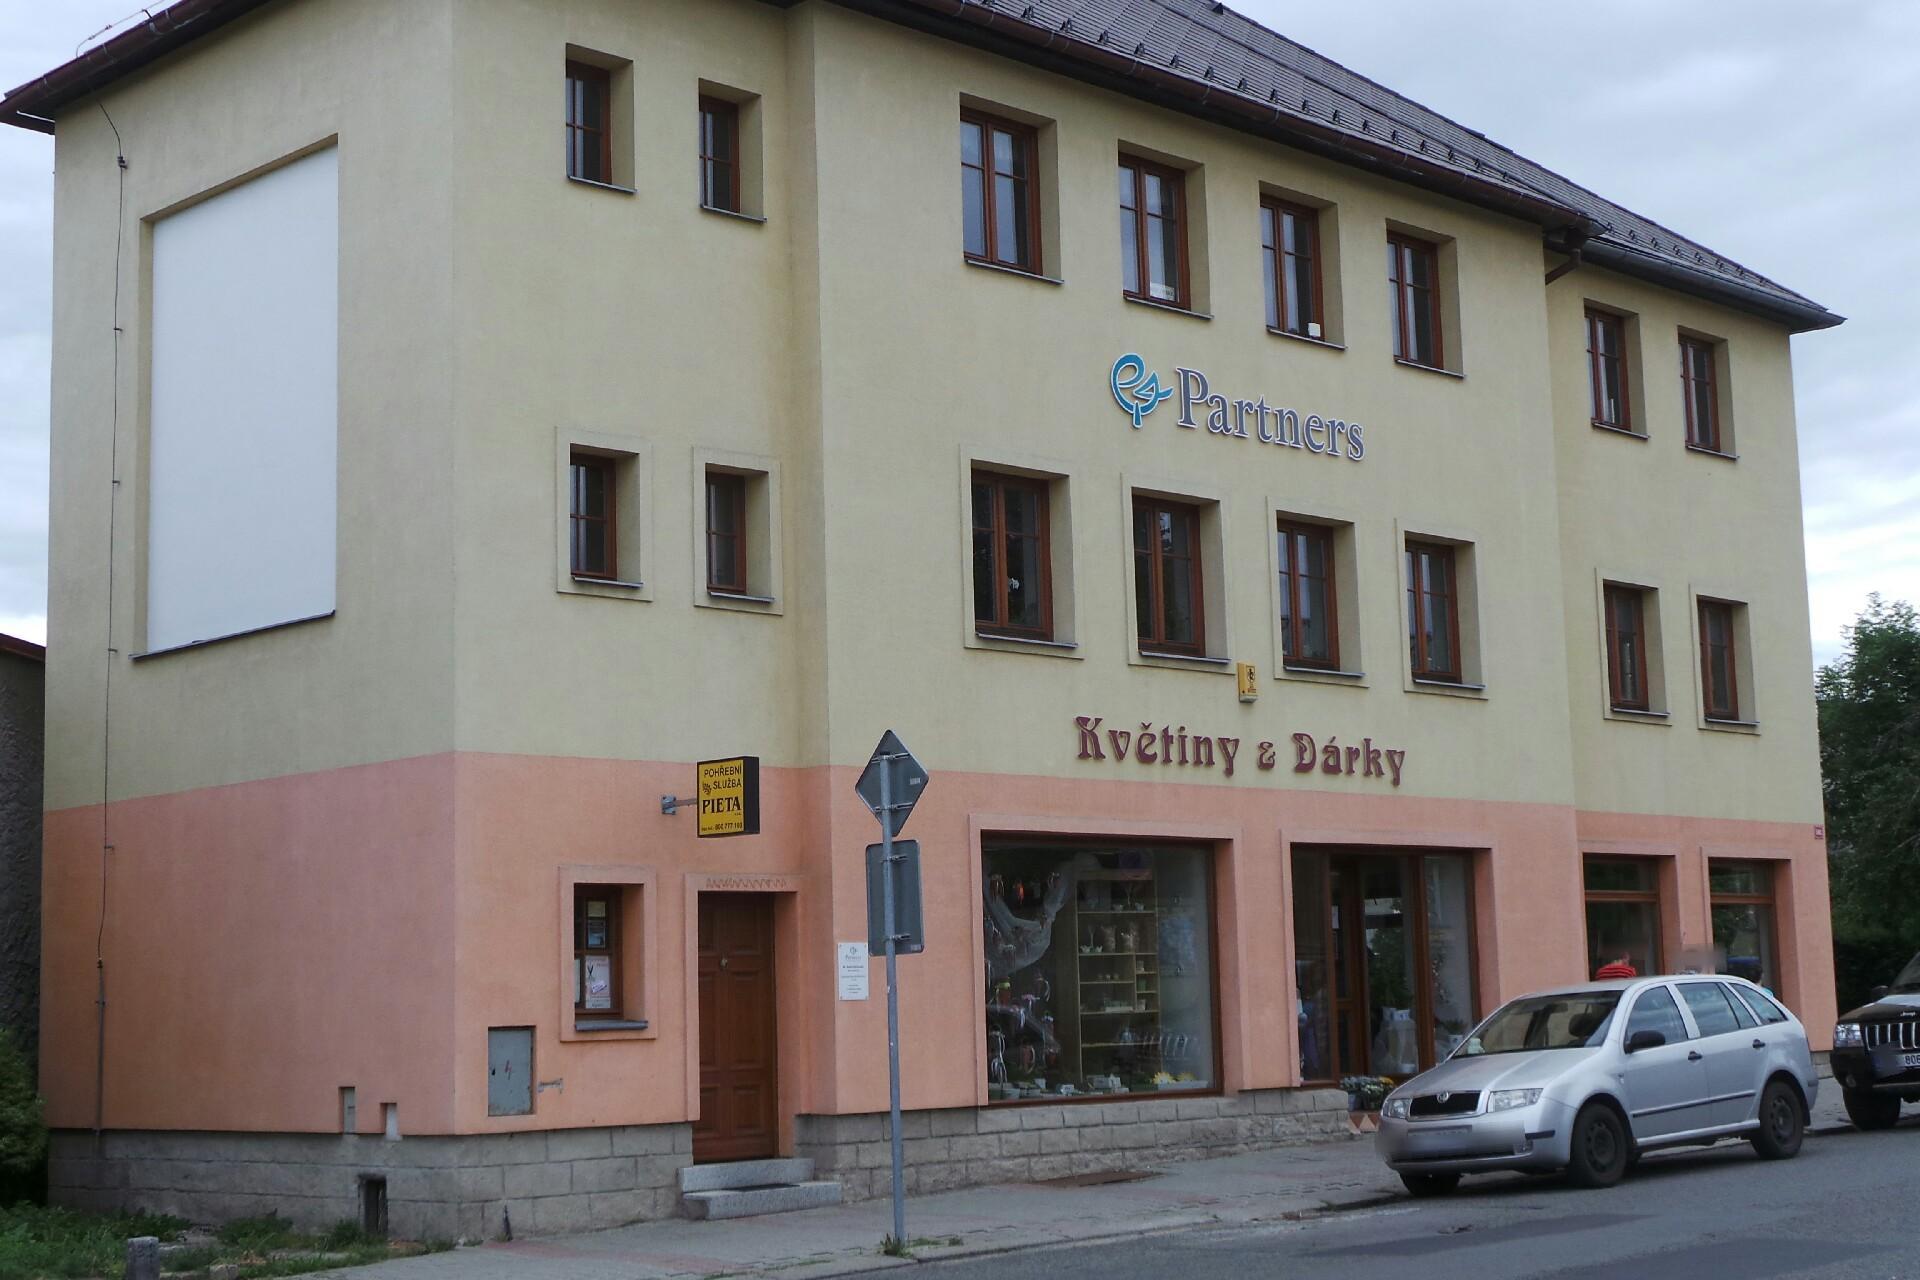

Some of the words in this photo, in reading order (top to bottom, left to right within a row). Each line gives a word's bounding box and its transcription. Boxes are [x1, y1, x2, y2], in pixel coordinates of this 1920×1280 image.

[1176, 367, 1365, 461] Partners
[1075, 716, 1240, 777] Květiny
[1257, 741, 1276, 770] &
[1292, 732, 1406, 786] Dárky
[704, 765, 742, 778] POHŘEBNÍ
[713, 778, 742, 790] SLUŽBA
[702, 796, 742, 814] PIETA
